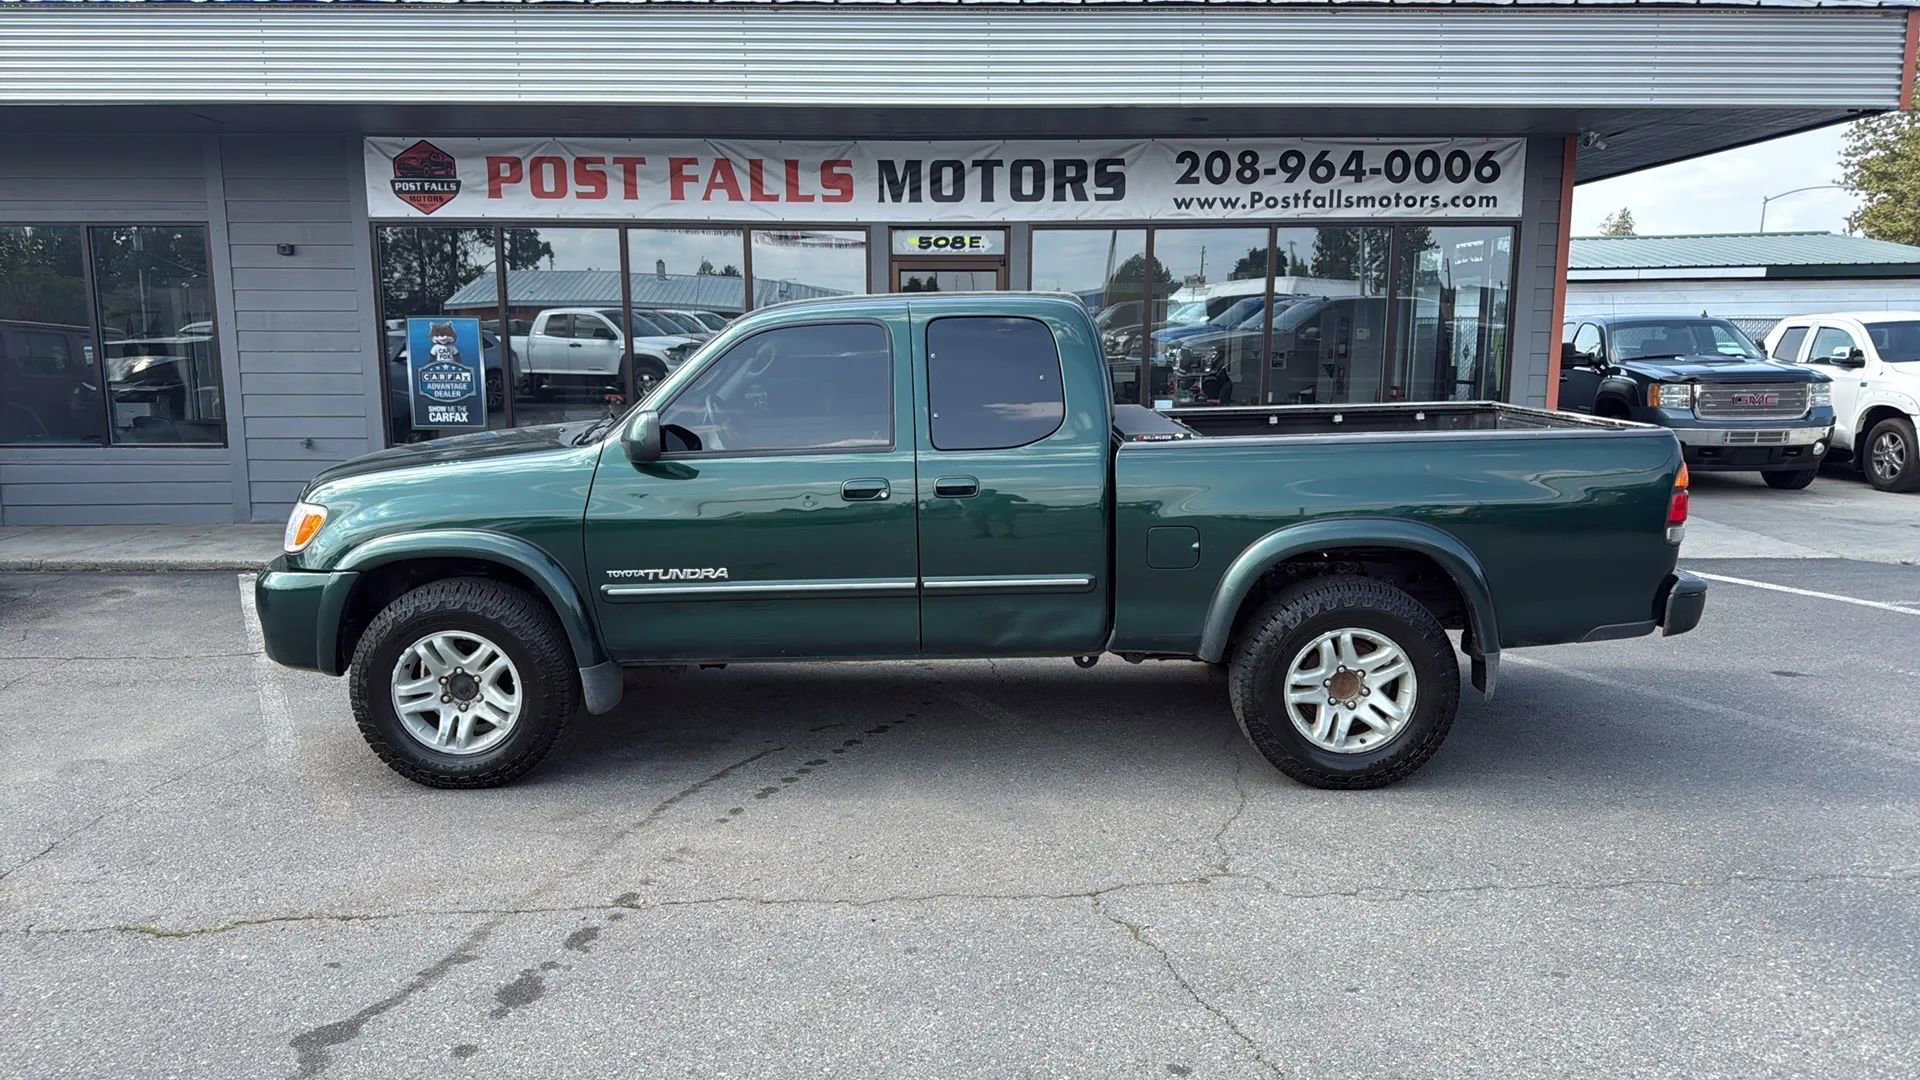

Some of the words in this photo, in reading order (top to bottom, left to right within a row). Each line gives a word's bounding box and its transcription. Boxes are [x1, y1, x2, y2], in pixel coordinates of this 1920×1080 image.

[1174, 149, 1501, 185] 208-964-0006
[485, 156, 647, 200] POST
[668, 157, 854, 203] FALLS
[877, 158, 1126, 203] MOTORS
[394, 182, 422, 191] POST
[424, 182, 457, 191] FALLS
[409, 195, 444, 203] MOTORS
[1172, 189, 1498, 210] www.Postfallsmotors.com
[917, 235, 966, 250] 508
[422, 372, 471, 382] CARFAX
[1731, 393, 1779, 407] GMC
[428, 412, 469, 423] CARFAX
[606, 570, 645, 578] TOYOTA
[644, 567, 729, 580] TUNDRA
